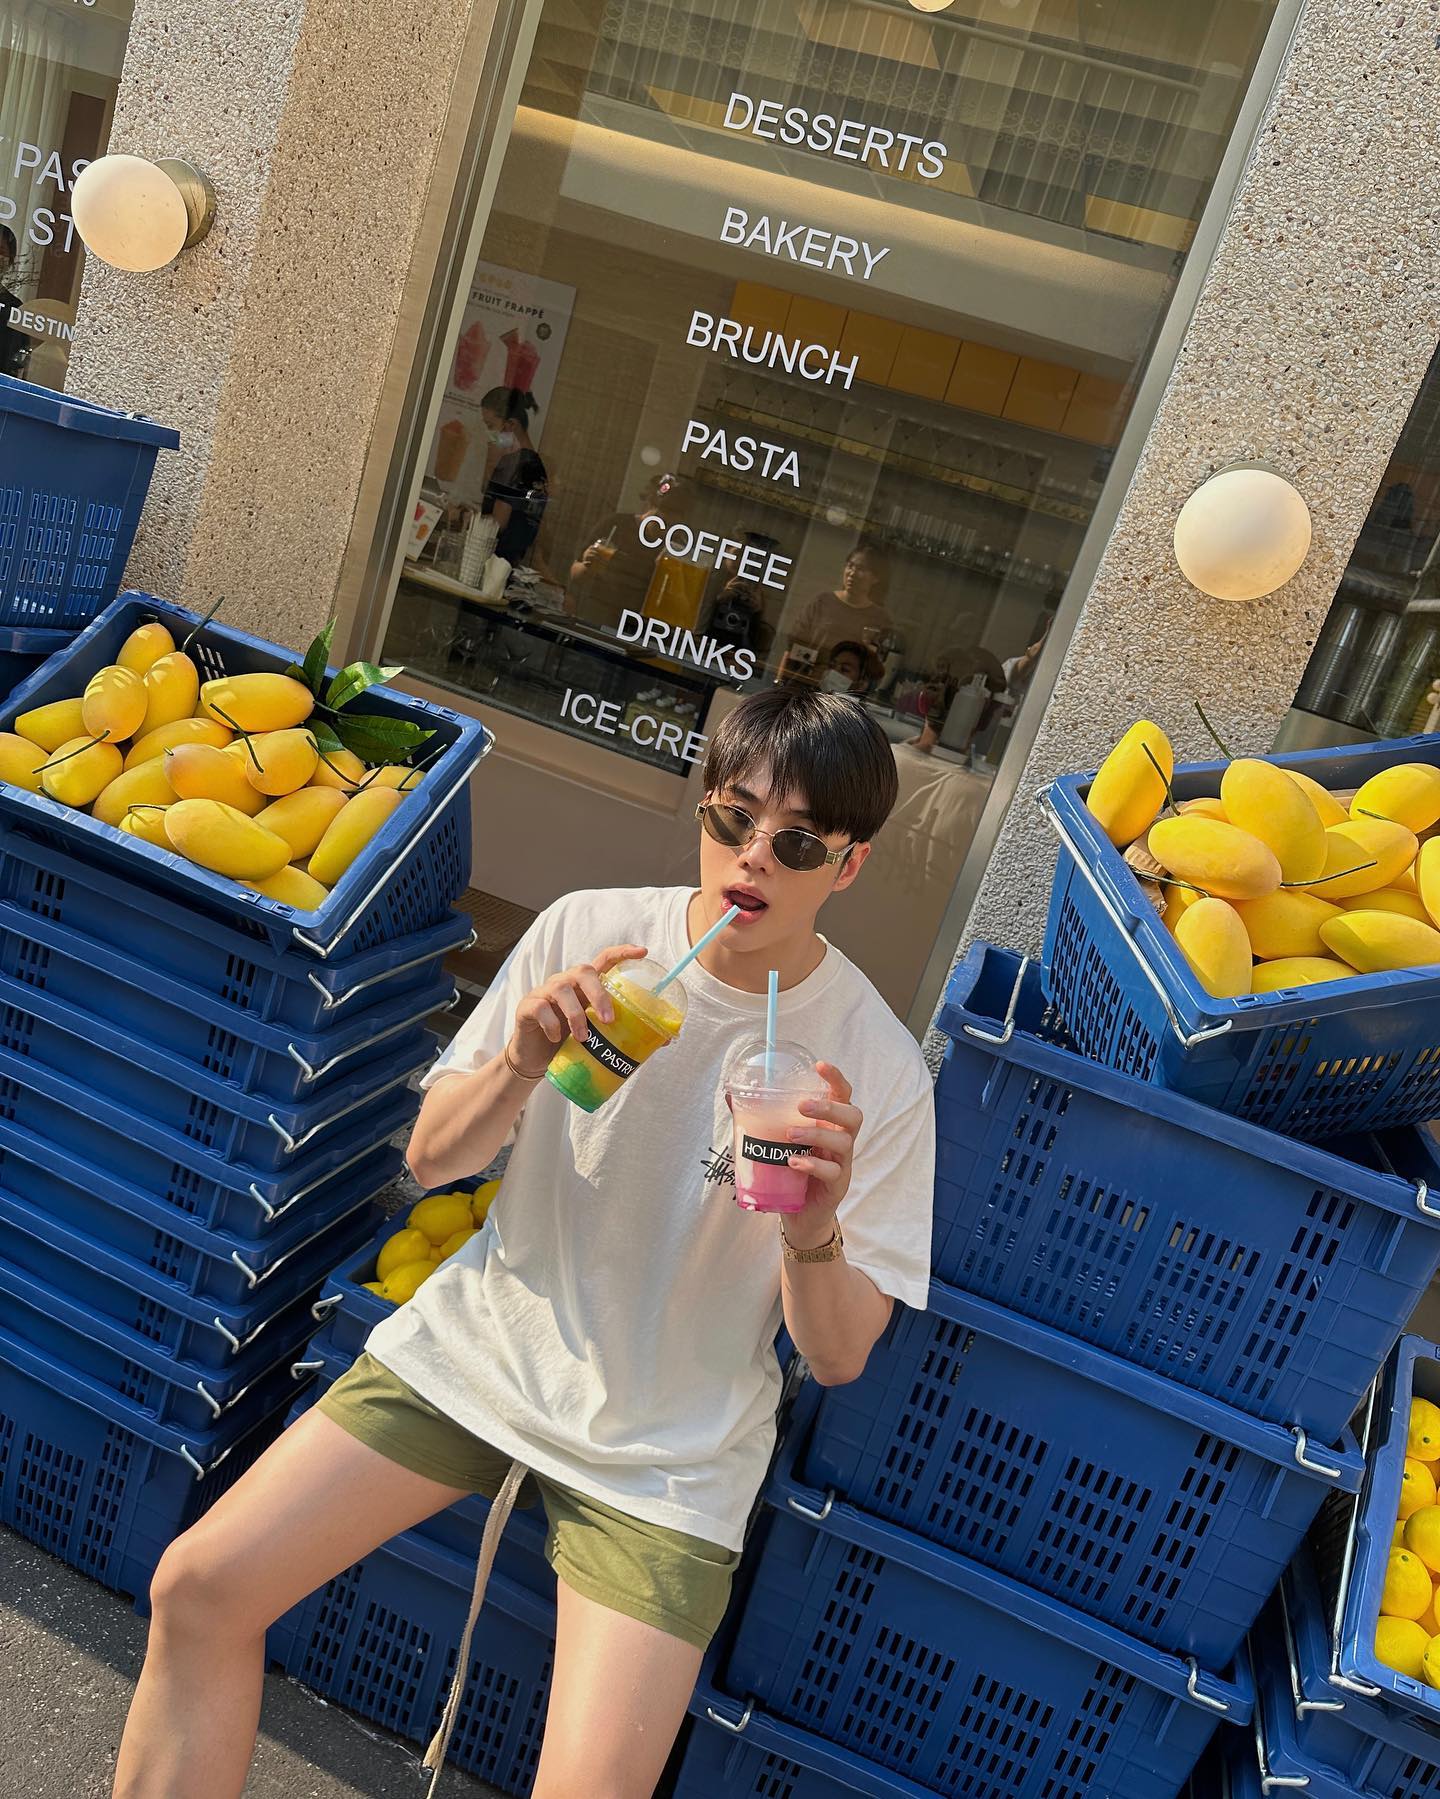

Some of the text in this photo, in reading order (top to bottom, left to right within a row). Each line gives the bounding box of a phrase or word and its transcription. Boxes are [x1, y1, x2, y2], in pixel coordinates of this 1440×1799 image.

[724, 93, 948, 180] DESSERTS
[720, 207, 890, 280] BAKERY
[471, 291, 502, 307] FRUIT
[686, 311, 859, 390] BRUNCH
[682, 420, 801, 488] PASTA
[638, 515, 793, 591] COFFEE
[616, 608, 757, 681] DRINKS
[559, 688, 709, 765] ICE-CRE
[600, 1048, 635, 1075] PASTRY
[744, 1141, 798, 1161] HOLIDAY
